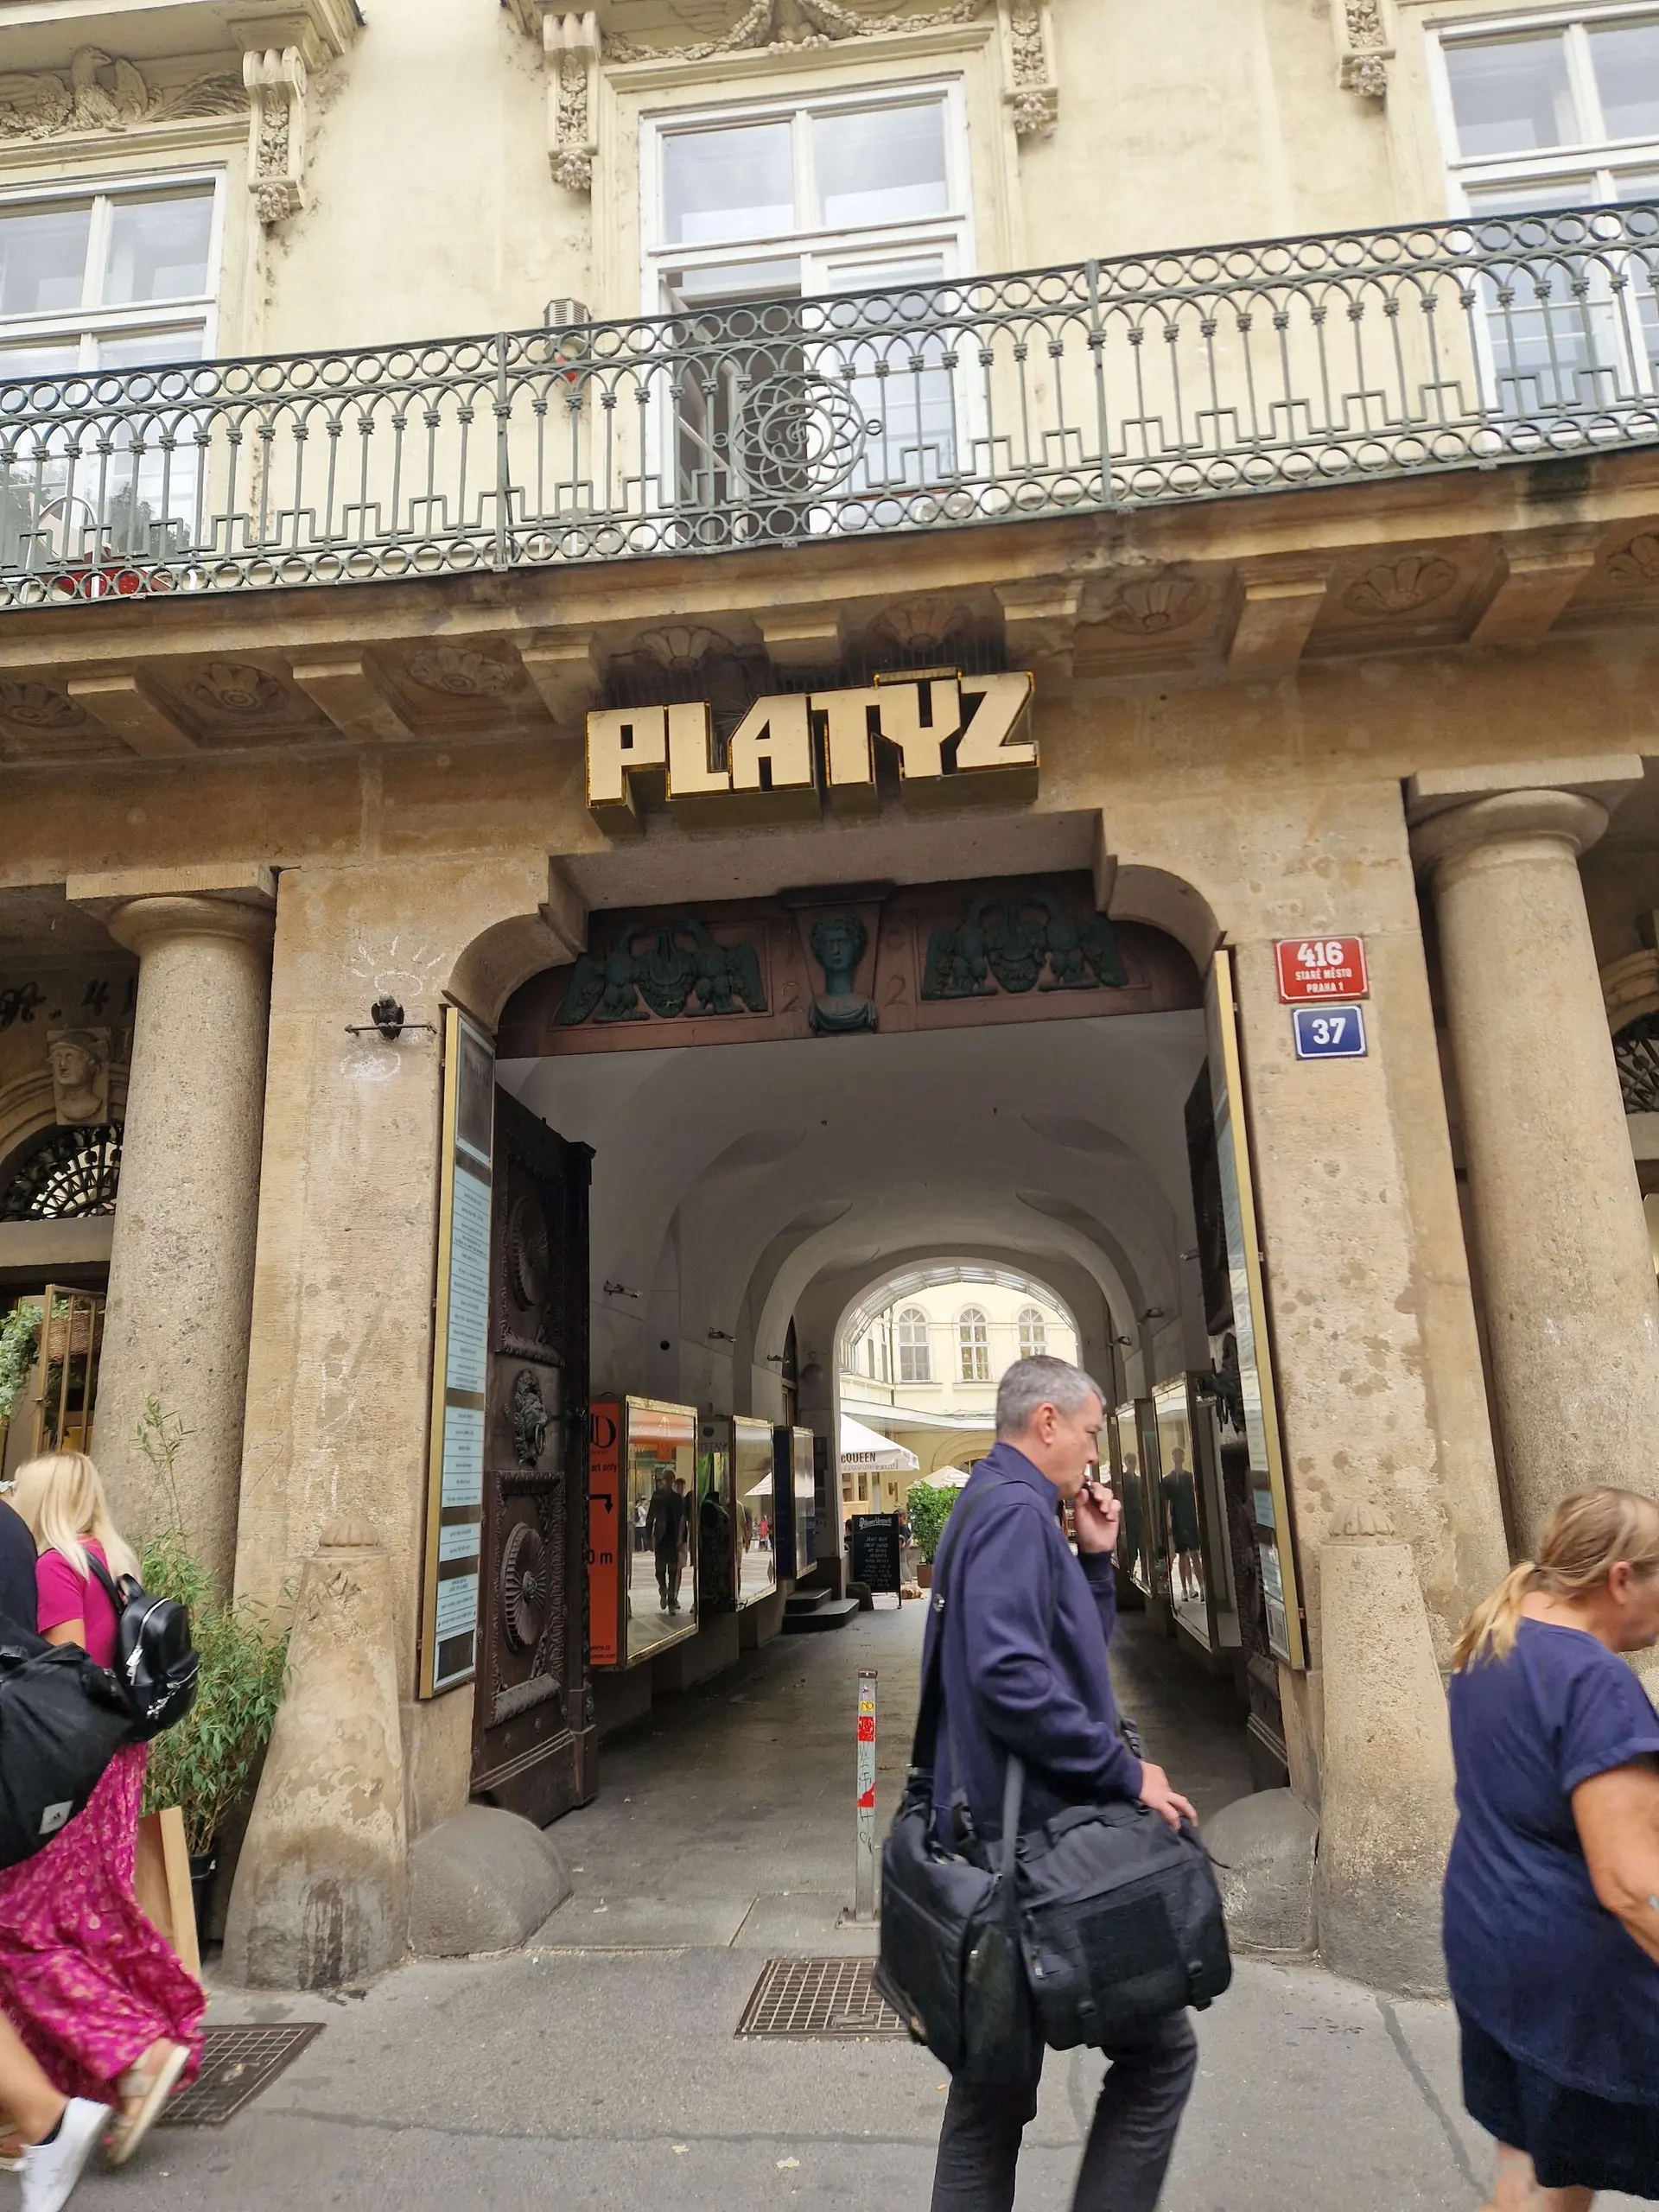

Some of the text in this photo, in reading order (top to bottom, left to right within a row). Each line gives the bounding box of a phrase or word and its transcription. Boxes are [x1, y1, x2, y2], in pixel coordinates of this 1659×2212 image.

[1296, 941, 1344, 968] 416
[1294, 967, 1352, 981] STARÉ MĚSTO
[1306, 982, 1344, 994] PRAHA 1
[1312, 1017, 1346, 1045] 37
[600, 1551, 613, 1565] m
